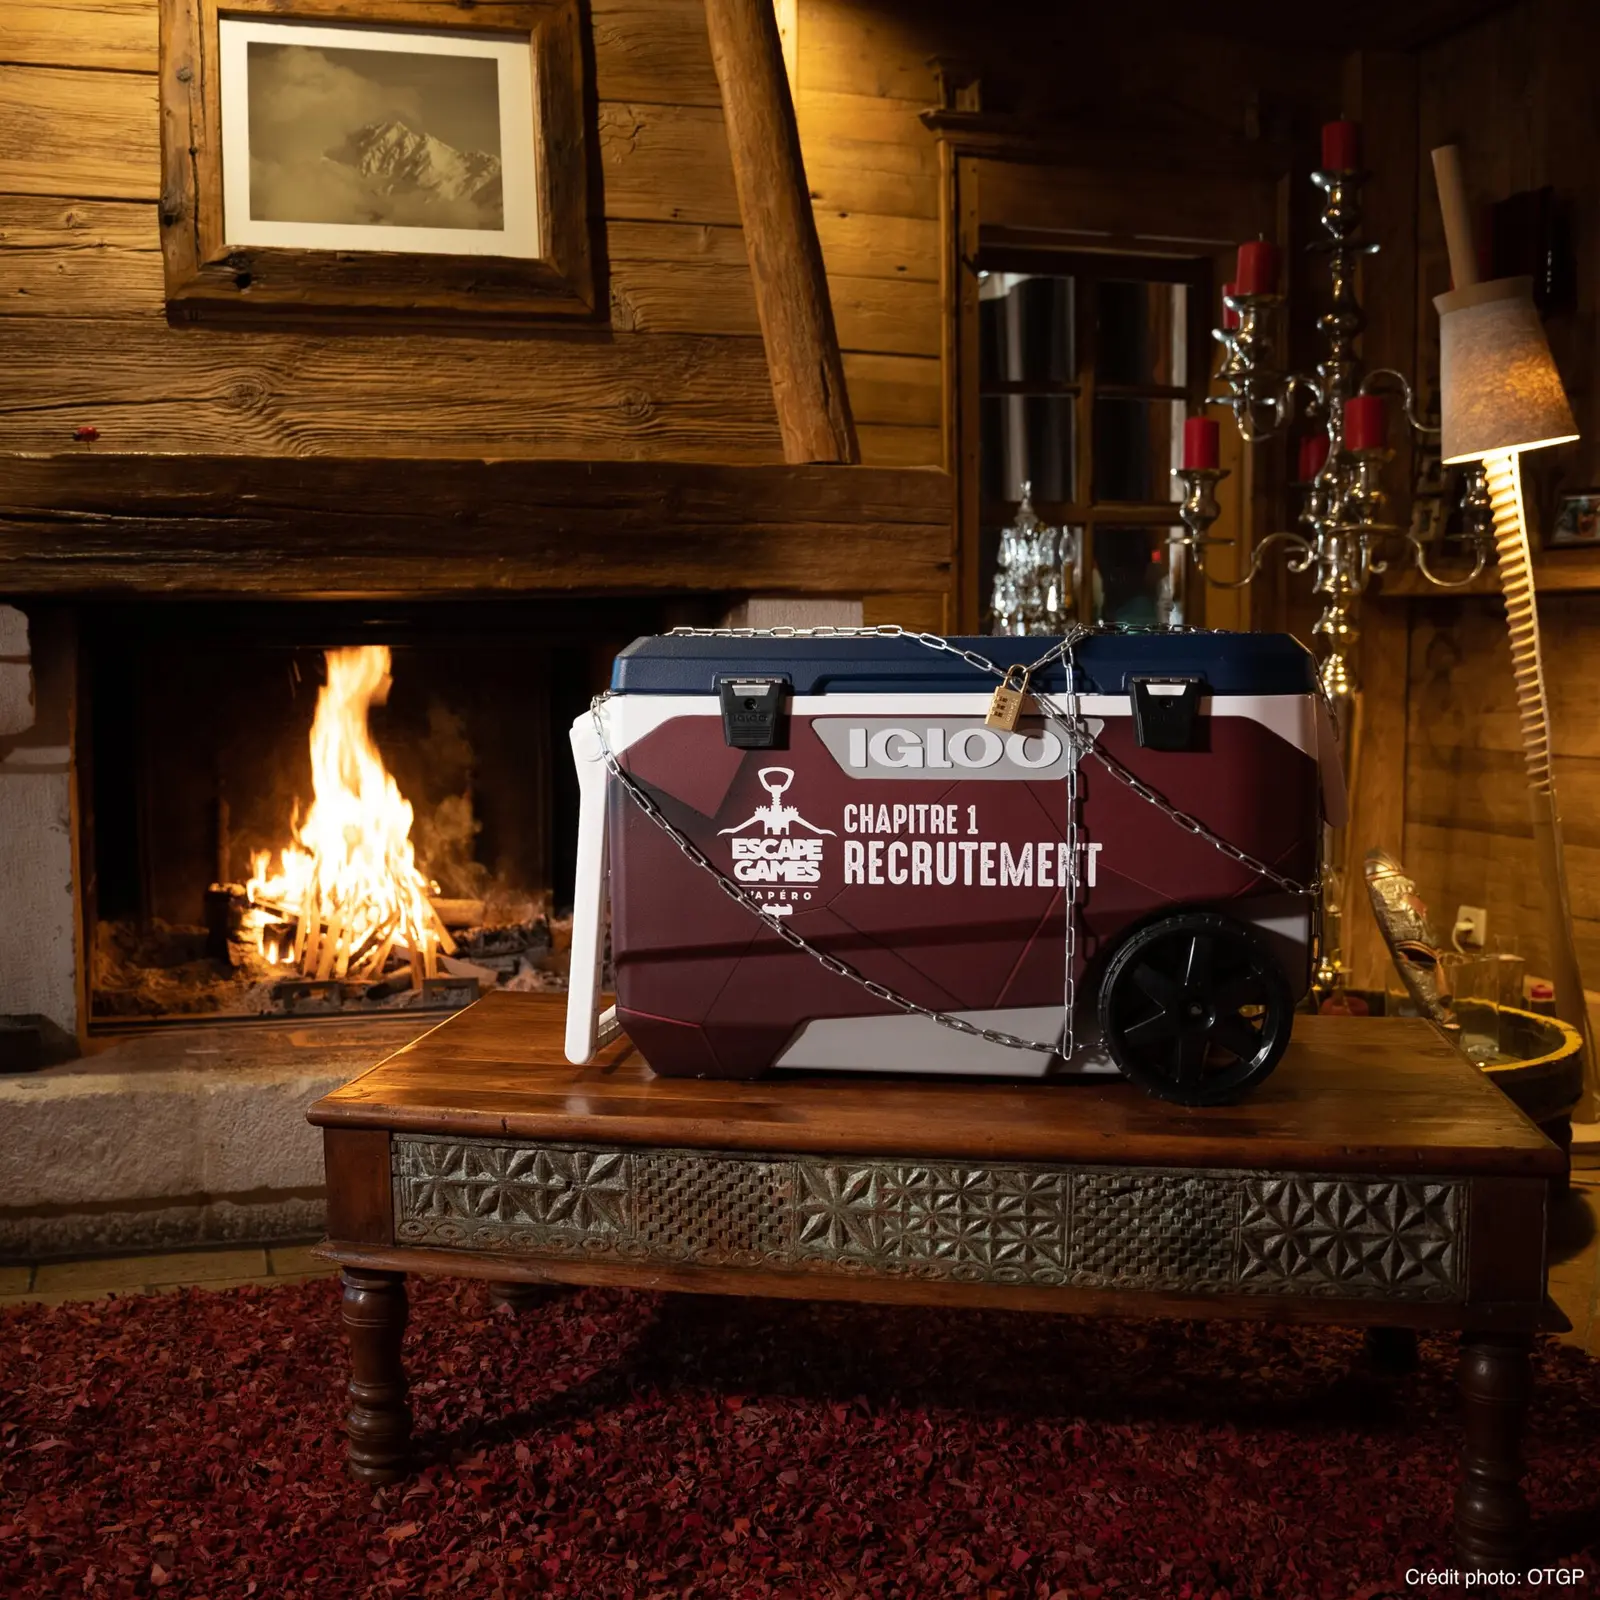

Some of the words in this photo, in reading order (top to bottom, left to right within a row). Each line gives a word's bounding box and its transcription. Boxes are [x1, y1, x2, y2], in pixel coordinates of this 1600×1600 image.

[849, 728, 1062, 769] IGLOO
[843, 804, 958, 834] CHAPITRE
[967, 804, 979, 835] 1
[732, 838, 823, 861] ESCAPE
[733, 860, 821, 883] GAMES
[844, 841, 1103, 888] RECRUTEMENT
[744, 889, 812, 901] 'APÉRO
